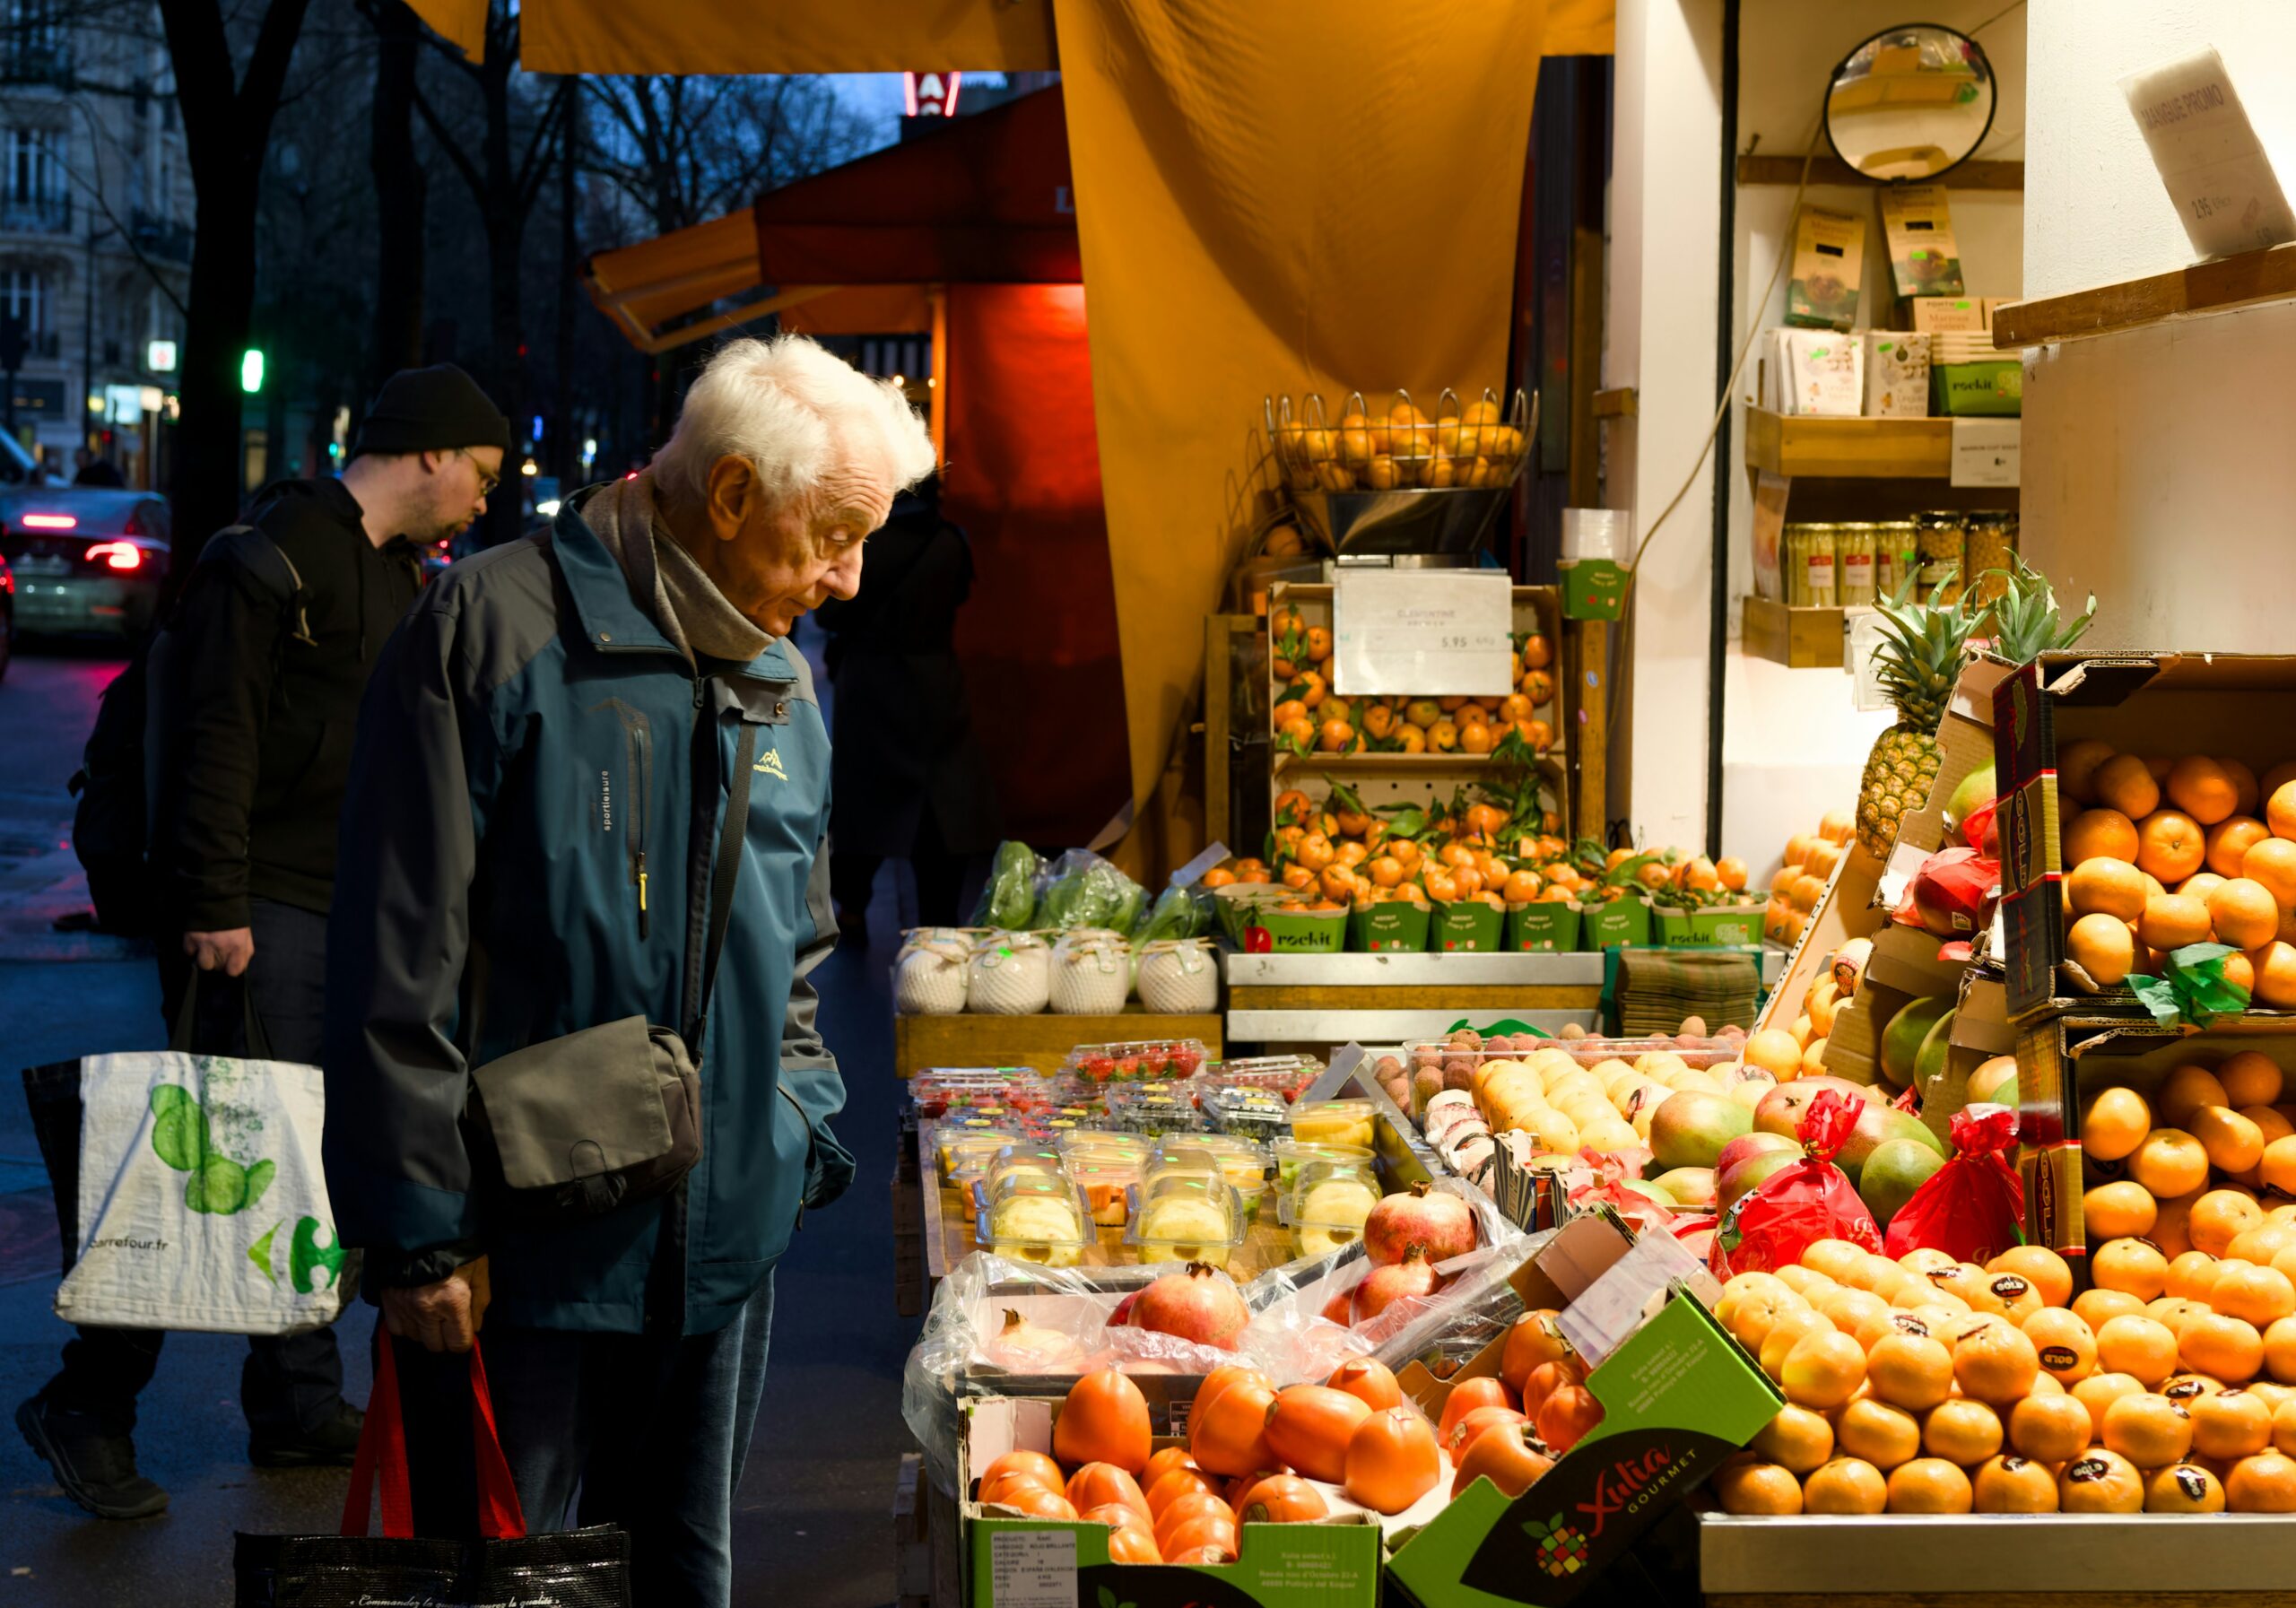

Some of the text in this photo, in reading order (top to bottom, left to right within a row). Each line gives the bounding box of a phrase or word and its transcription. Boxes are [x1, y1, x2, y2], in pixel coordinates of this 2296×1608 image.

[2141, 83, 2224, 131] MANGUE PROMO
[1952, 378, 1993, 391] rockit
[1396, 609, 1456, 618] CLEMENTINE
[1441, 636, 1468, 648] 5.95
[601, 770, 613, 831] sportleisure
[2015, 789, 2027, 890] GOLD
[1277, 931, 1332, 947] rockit
[1671, 933, 1710, 943] rockit
[90, 1237, 169, 1250] carrefour.fr
[1996, 1281, 2025, 1291] GOLD
[2044, 1353, 2074, 1364] GOLD
[2073, 1463, 2104, 1477] GOLD
[1628, 1448, 1697, 1514] GOURMET
[1576, 1443, 1671, 1538] Xulia
[358, 1594, 421, 1608] Commandez
[422, 1595, 434, 1608] la
[509, 1595, 517, 1608] la
